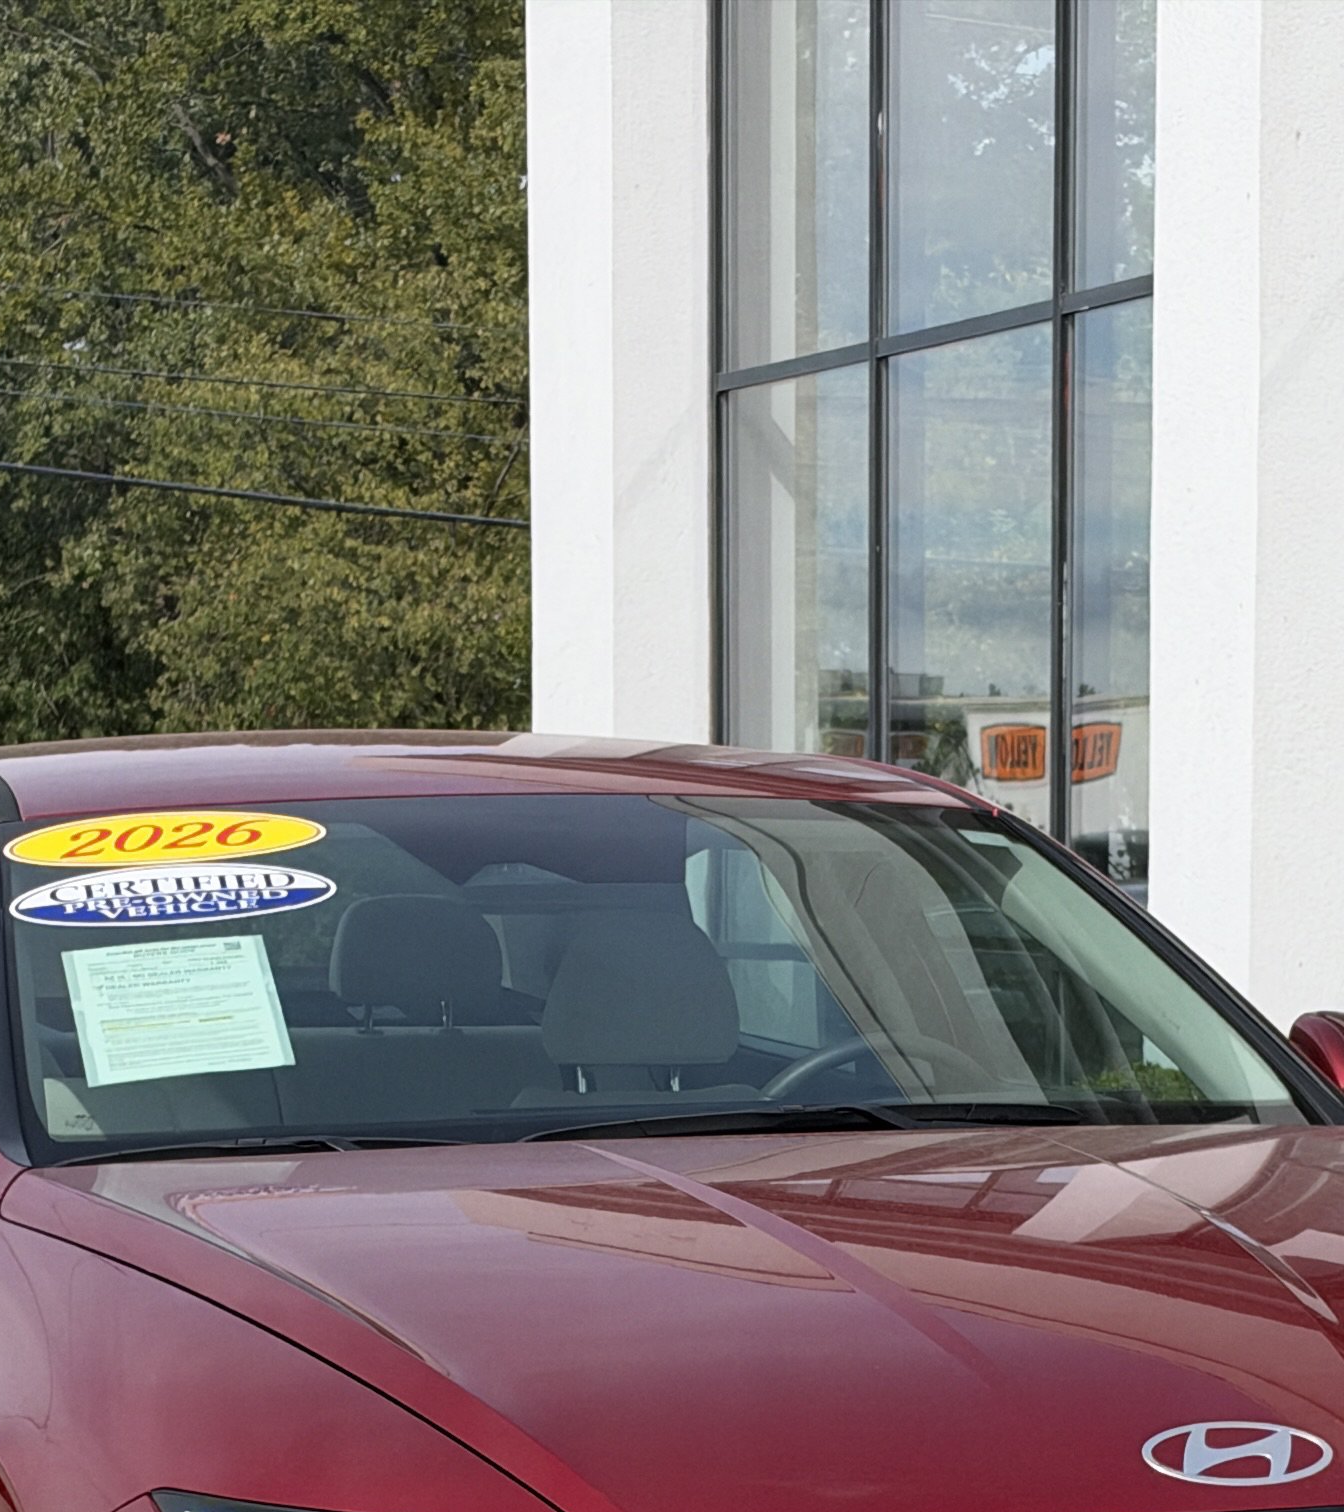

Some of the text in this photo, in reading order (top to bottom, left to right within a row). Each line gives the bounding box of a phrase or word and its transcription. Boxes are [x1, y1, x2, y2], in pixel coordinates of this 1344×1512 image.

[60, 820, 269, 859] 2026
[50, 873, 295, 902] CERTIFIED
[64, 890, 289, 914] PRE-OWNED
[98, 900, 260, 919] VEHICLE
